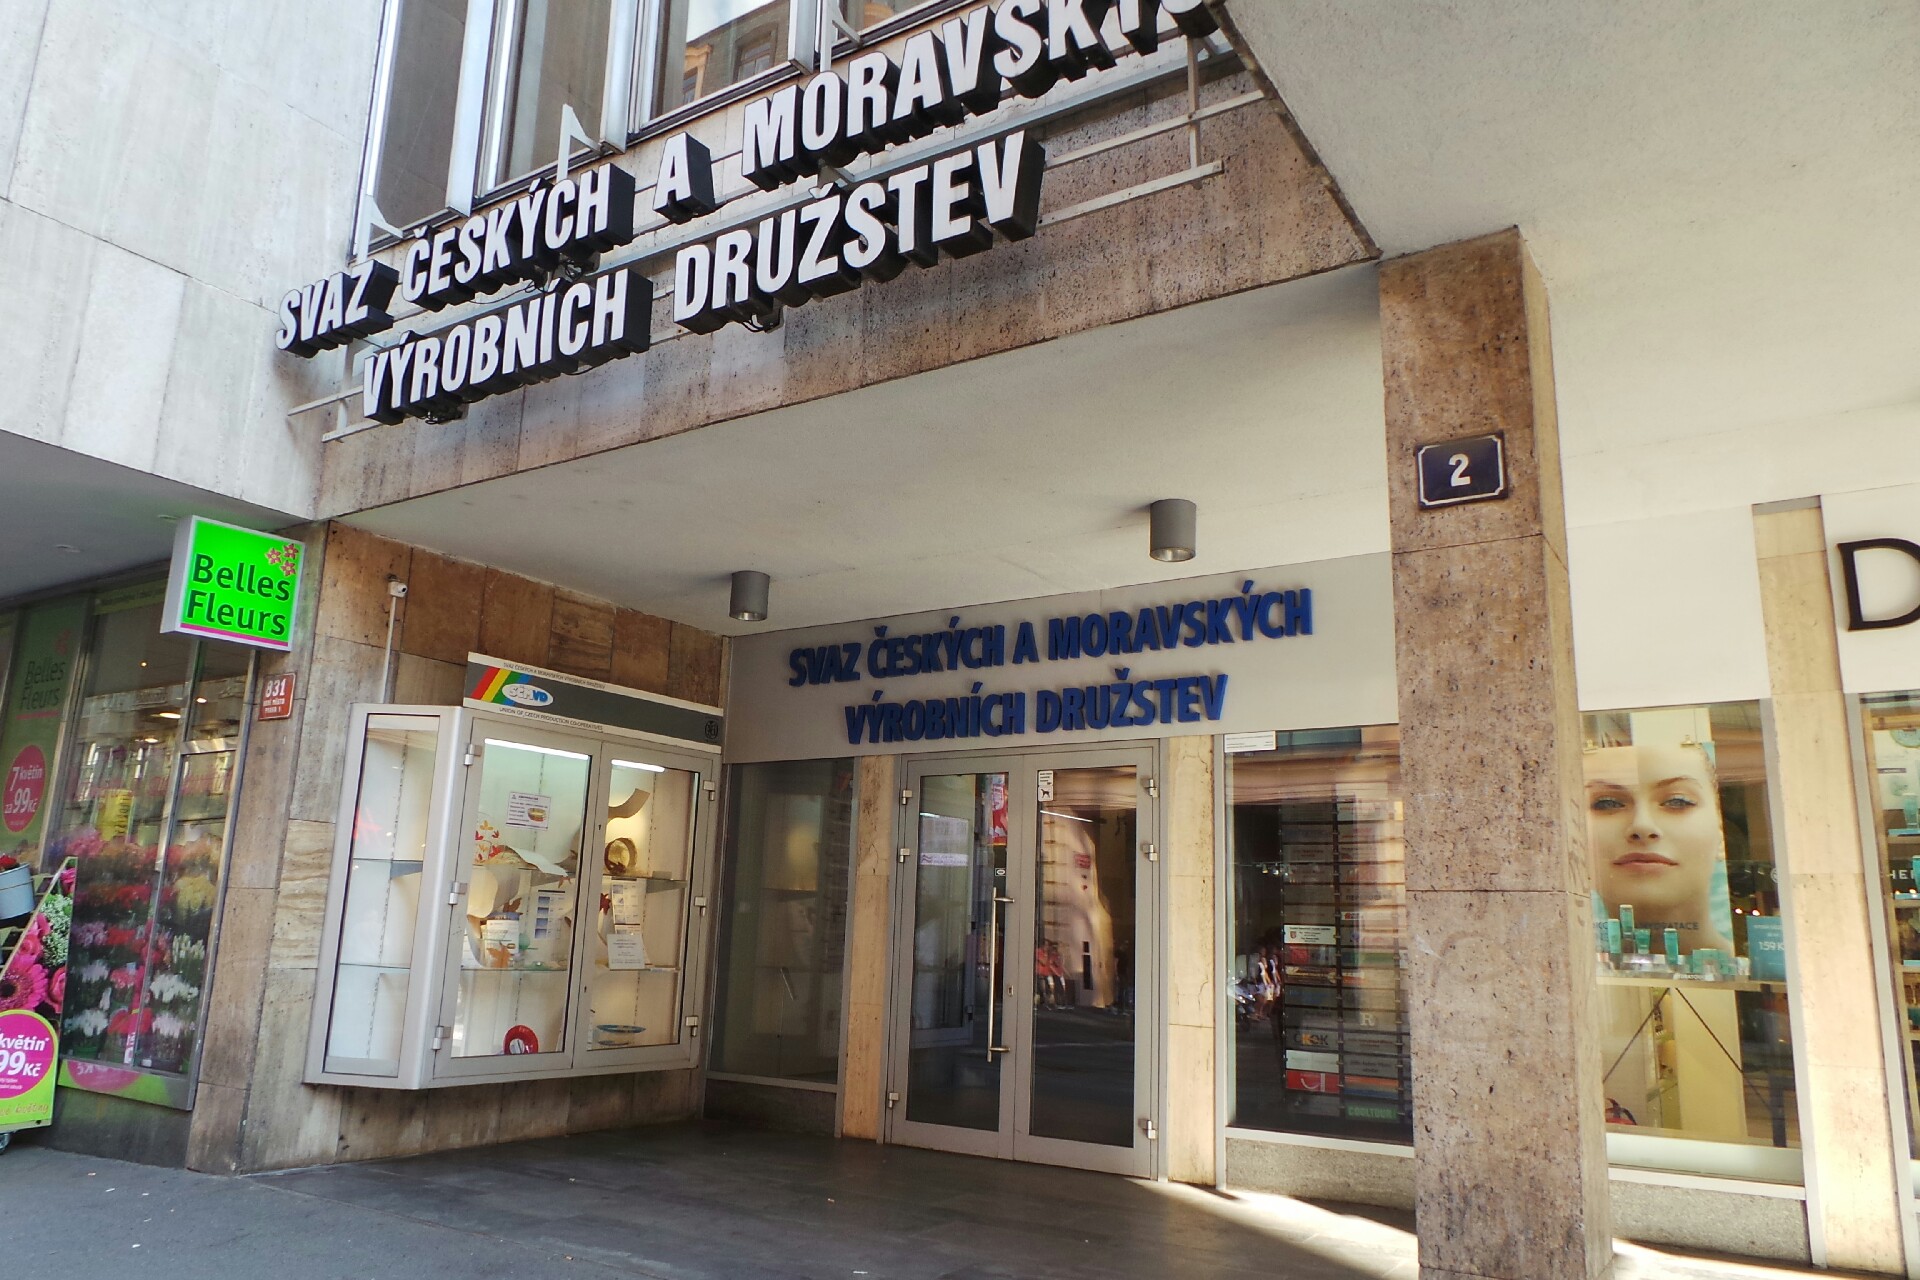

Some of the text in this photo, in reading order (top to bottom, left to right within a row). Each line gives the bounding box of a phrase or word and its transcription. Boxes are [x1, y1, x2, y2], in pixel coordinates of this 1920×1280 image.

[276, 0, 1203, 351] SVAZ ČESKÝCH A MORAVSK
[363, 129, 1027, 419] VÝROBNÍCH DRUŽSTEV
[1449, 453, 1471, 487] 2
[192, 553, 291, 602] Belles
[186, 590, 286, 636] Fleurs
[789, 580, 1313, 687] SVAZ ČESKÝCH A MORAVSKÝCH
[25, 659, 65, 685] Belles
[265, 678, 286, 698] 831
[845, 667, 1229, 745] VÝROBNÍCH DRUŽSTEV
[10, 766, 18, 791] 7
[13, 788, 31, 813] 99
